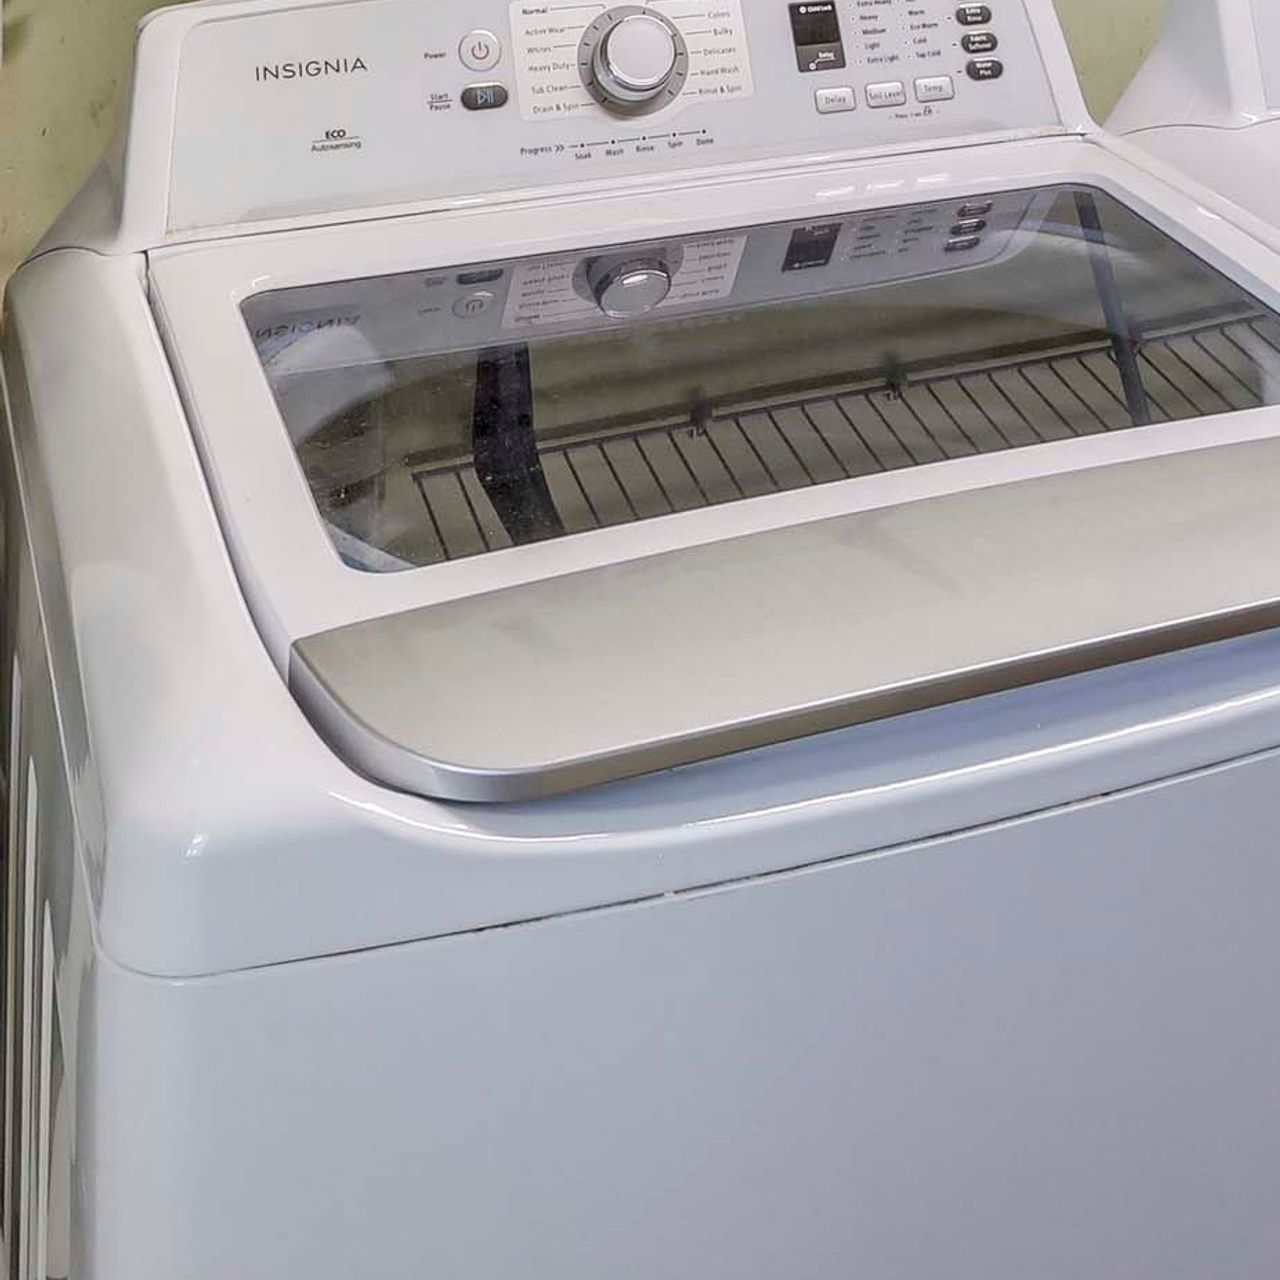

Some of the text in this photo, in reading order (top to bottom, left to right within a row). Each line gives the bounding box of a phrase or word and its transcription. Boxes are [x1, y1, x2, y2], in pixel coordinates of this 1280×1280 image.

[522, 6, 547, 15] Normal
[255, 57, 368, 81] INSIGNIA
[824, 95, 846, 104] Delay
[533, 105, 553, 114] Drain
[325, 129, 346, 139] ECO
[520, 146, 552, 155] Progress
